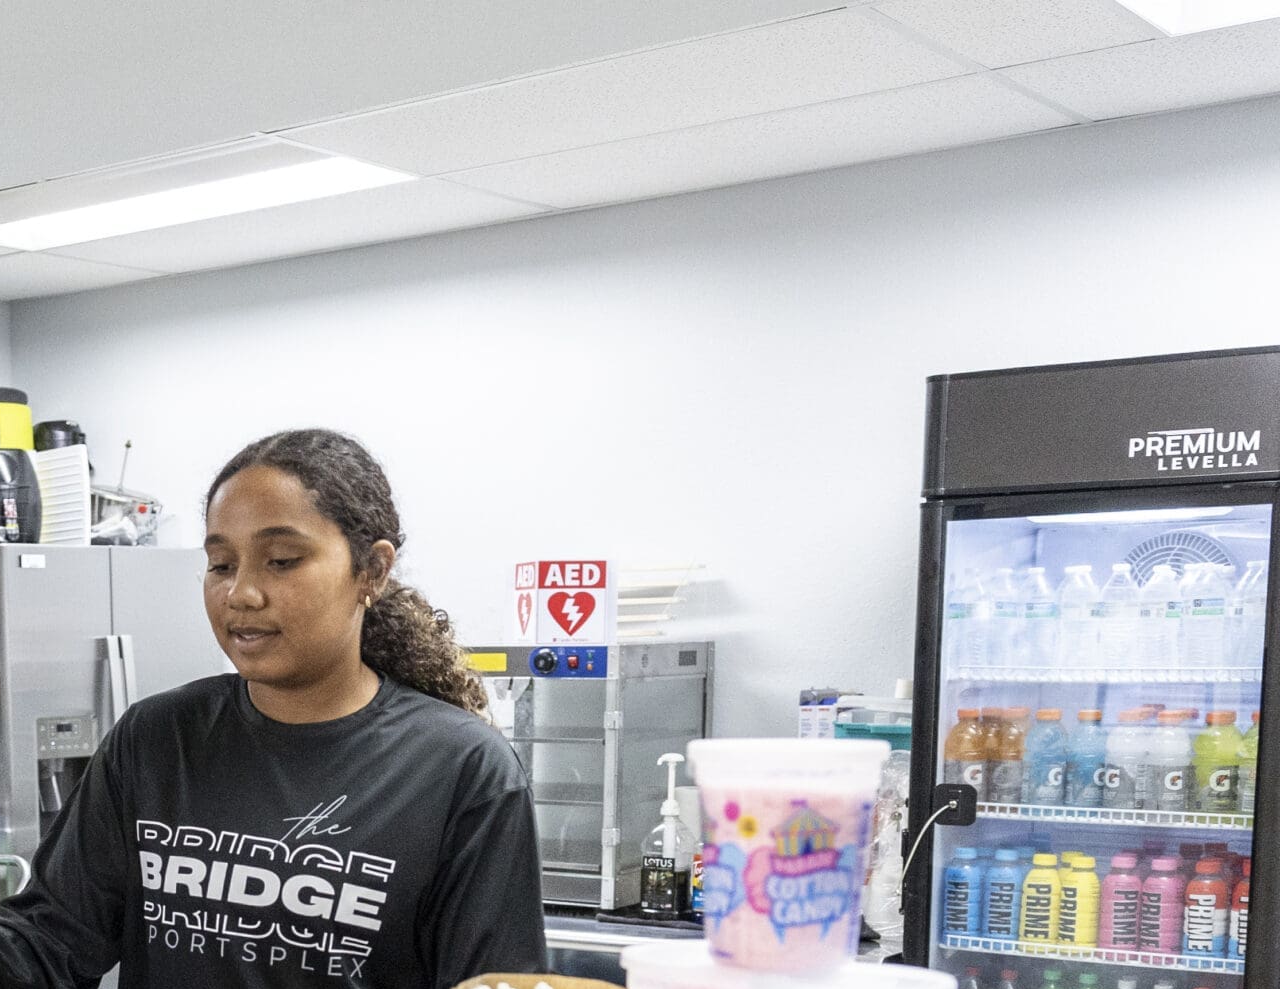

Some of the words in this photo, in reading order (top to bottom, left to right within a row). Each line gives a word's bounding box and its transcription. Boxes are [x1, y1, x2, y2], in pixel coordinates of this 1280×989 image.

[1128, 428, 1261, 458] PREMIUM
[1157, 452, 1258, 471] LEVELLA
[544, 563, 601, 587] AED
[272, 795, 352, 851] the
[644, 858, 673, 868] LOTUS
[138, 850, 388, 932] BRIDGE
[946, 880, 969, 932] PRIME
[987, 881, 1016, 936] PRIME
[1024, 883, 1053, 940] PRIME
[1057, 886, 1078, 943] PRIME
[1111, 890, 1140, 946] PRIME
[1139, 891, 1162, 949] PRIME
[1186, 894, 1217, 953] PRIME
[148, 924, 368, 979] PORTSPLEX
